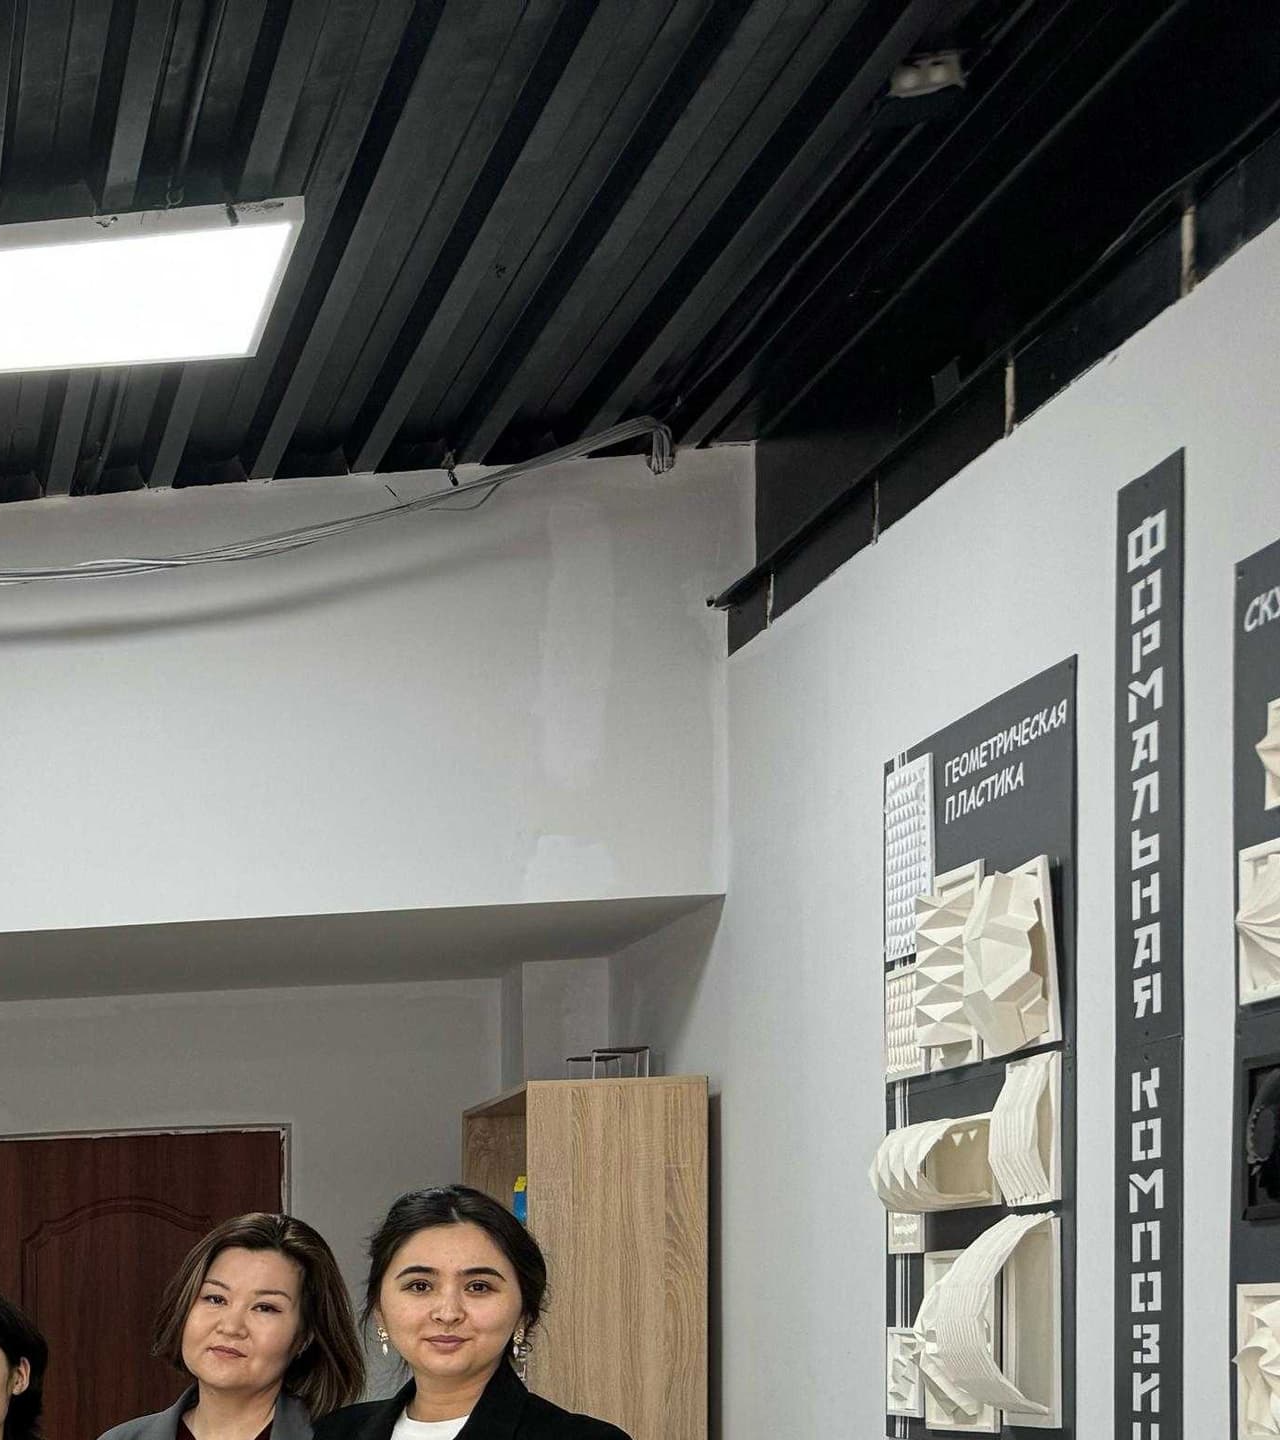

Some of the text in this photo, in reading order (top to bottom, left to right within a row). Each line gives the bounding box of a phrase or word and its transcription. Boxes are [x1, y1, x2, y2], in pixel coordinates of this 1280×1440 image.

[944, 698, 1067, 787] ГЕОМЕТРИЧЕСКАЯ
[1128, 509, 1167, 1019] ФОРМАЛЬНАЯ
[944, 761, 1024, 825] ПЛАСТИКА
